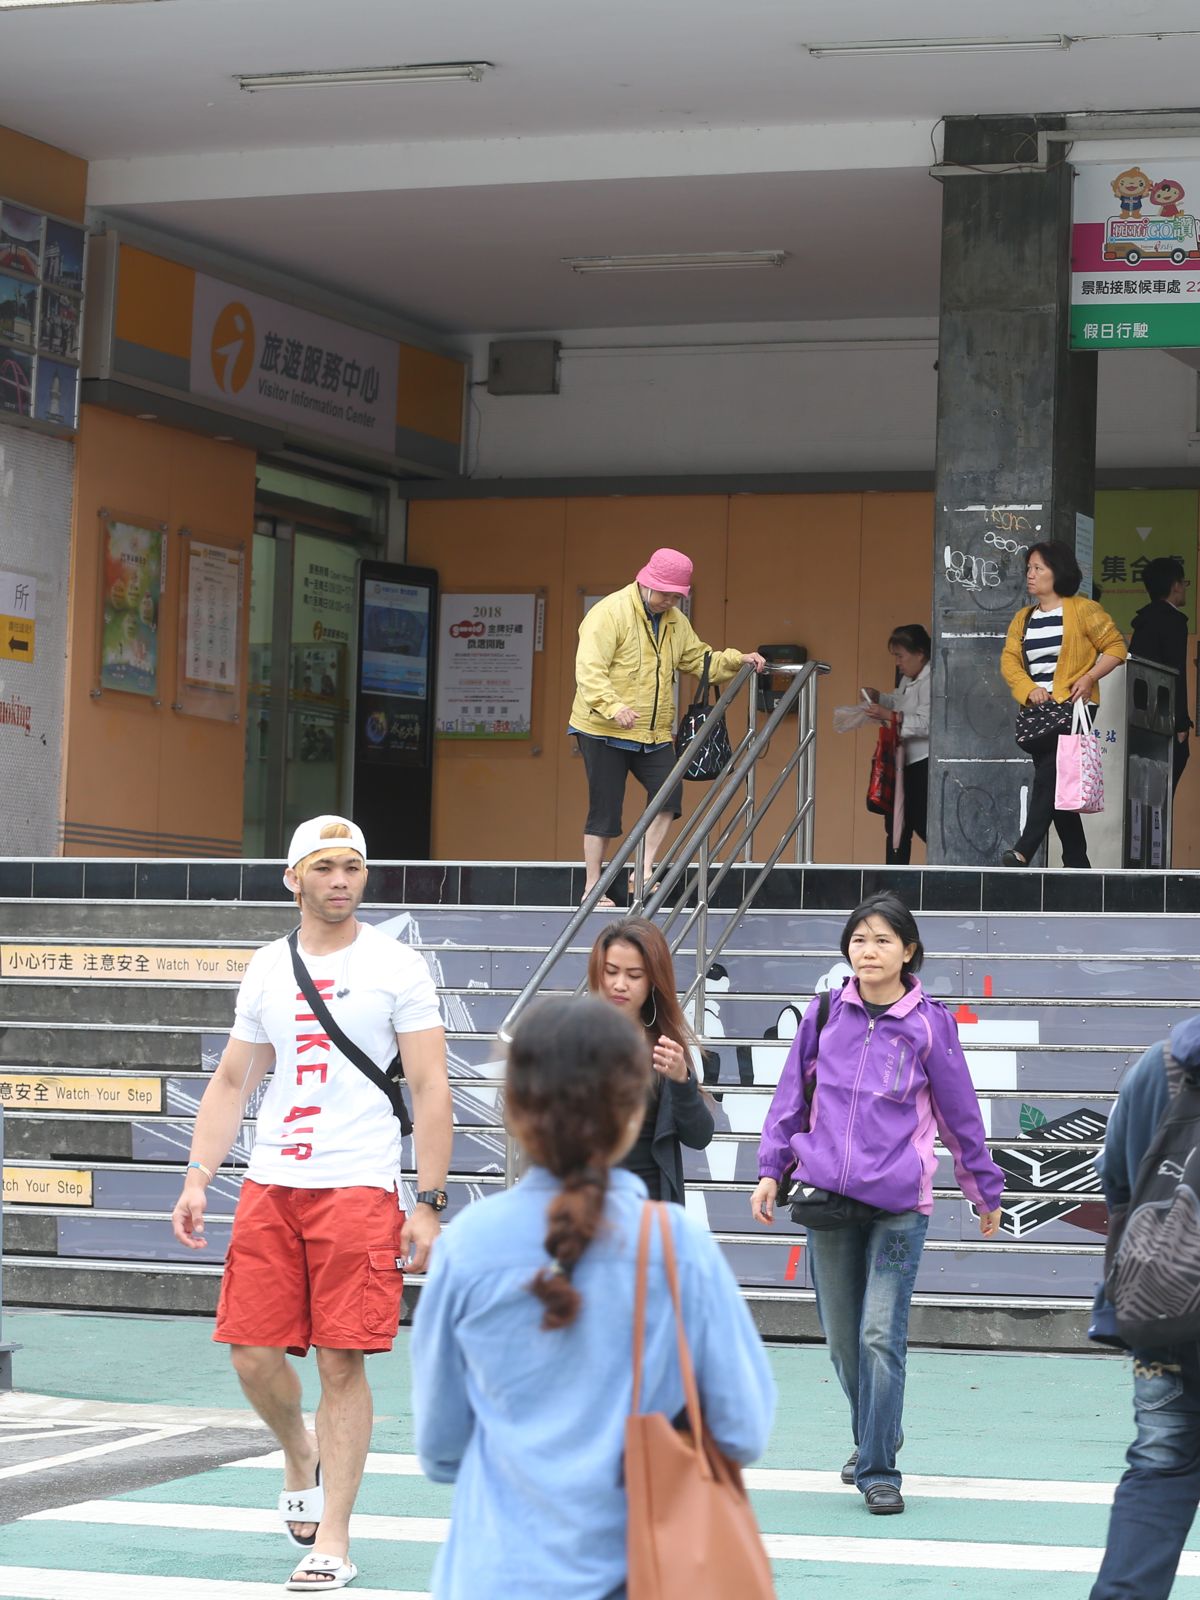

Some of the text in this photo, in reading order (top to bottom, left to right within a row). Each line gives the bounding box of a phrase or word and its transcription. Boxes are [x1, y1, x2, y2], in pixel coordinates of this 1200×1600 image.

[1081, 279, 1181, 295] 景點接駁候車處
[1082, 322, 1150, 339] 假日行駛
[259, 330, 380, 404] 旅遊服務中心
[257, 377, 377, 428] Visitor Information Center
[14, 583, 30, 611] 所
[472, 605, 502, 618] 2018
[8, 952, 74, 970] 小心行走
[82, 953, 151, 972] 注意安全
[155, 957, 190, 971] Watch
[196, 958, 220, 972] Your
[0, 1082, 153, 1104] 意安全 Watch Your Step
[2, 1178, 83, 1196] tch Your Step
